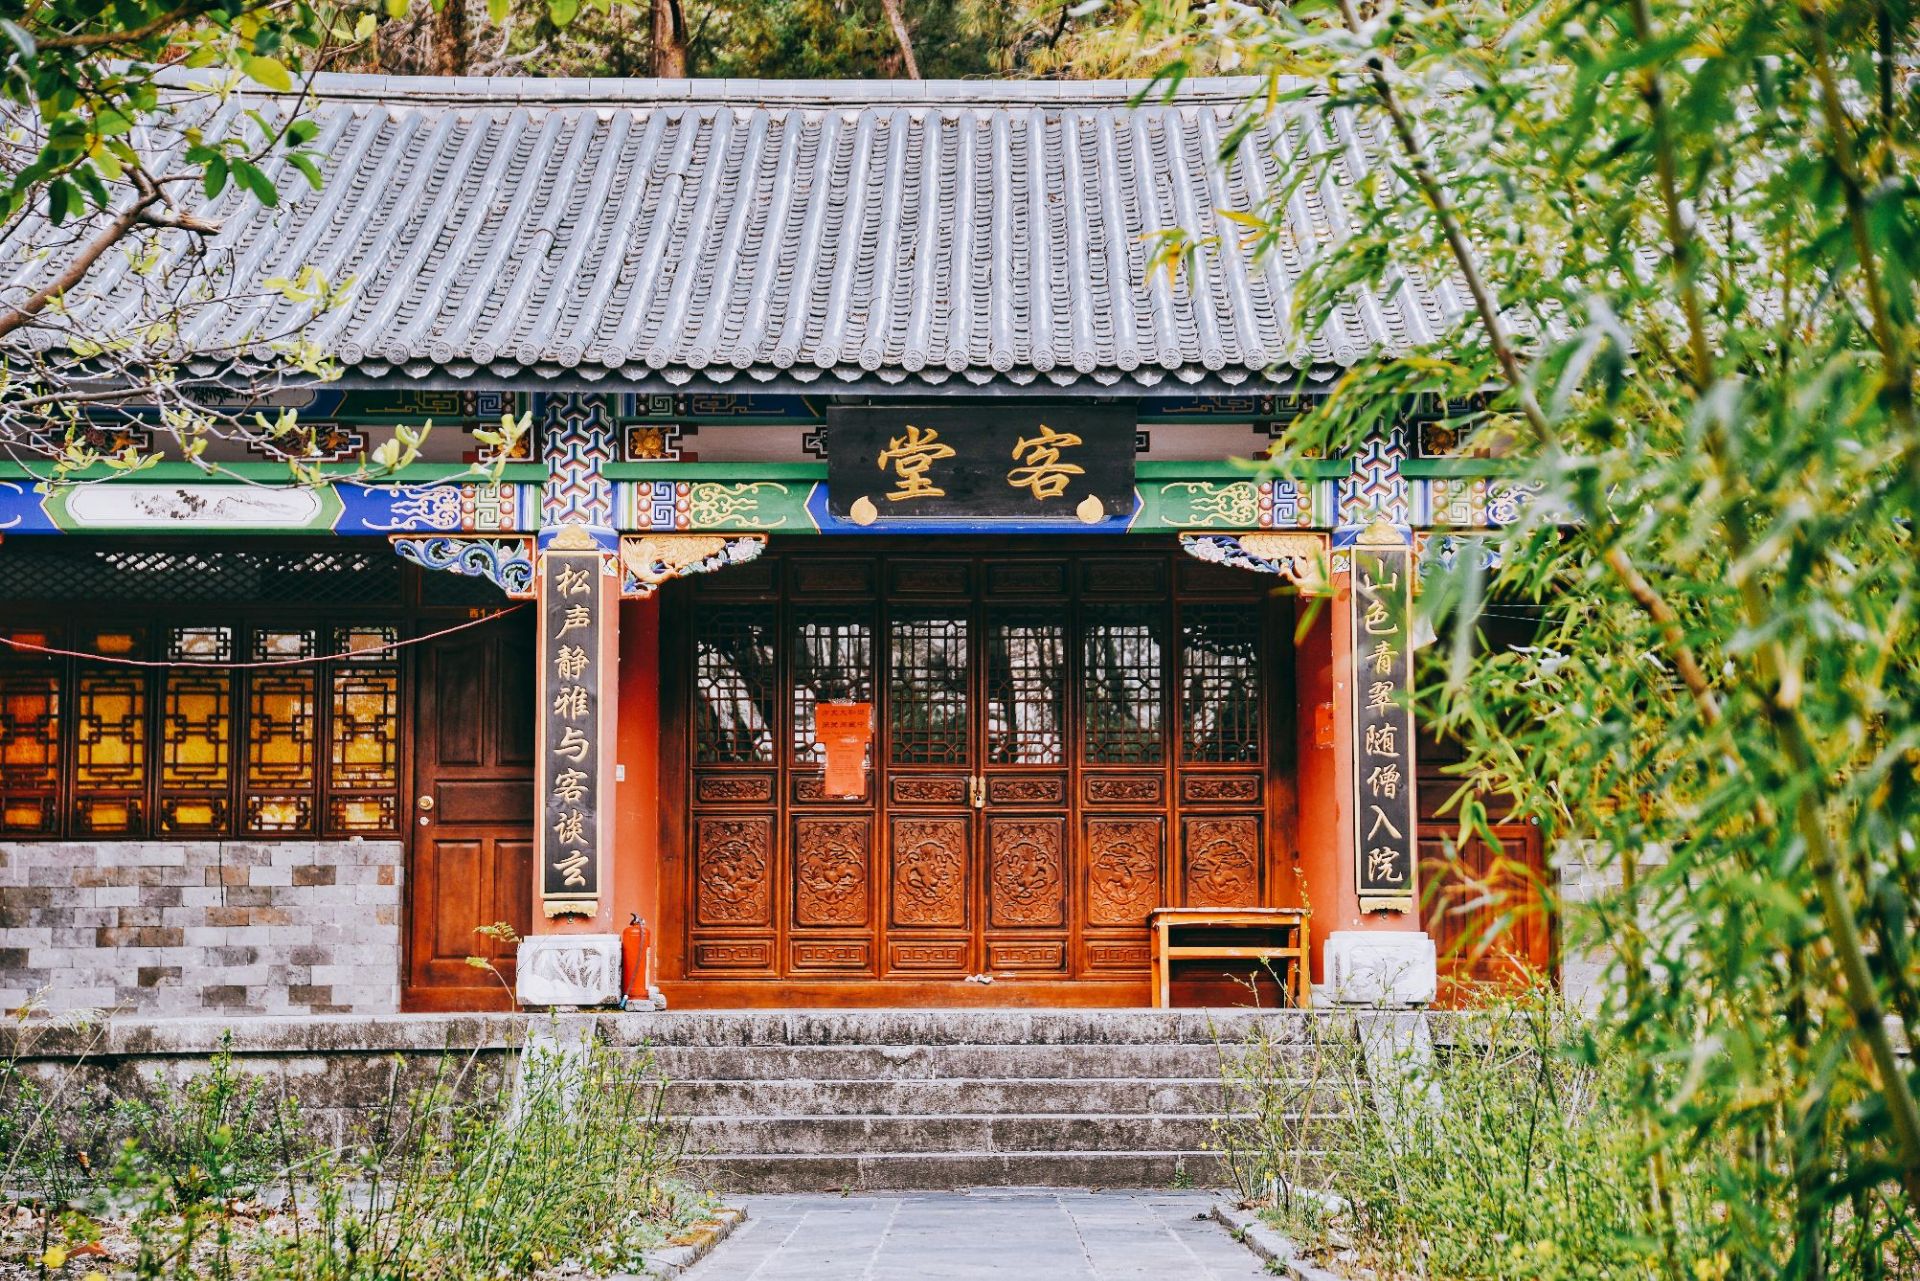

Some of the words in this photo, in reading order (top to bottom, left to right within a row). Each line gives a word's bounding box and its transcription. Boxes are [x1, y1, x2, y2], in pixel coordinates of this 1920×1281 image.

[553, 563, 592, 887] 松声静雅与客谈玄
